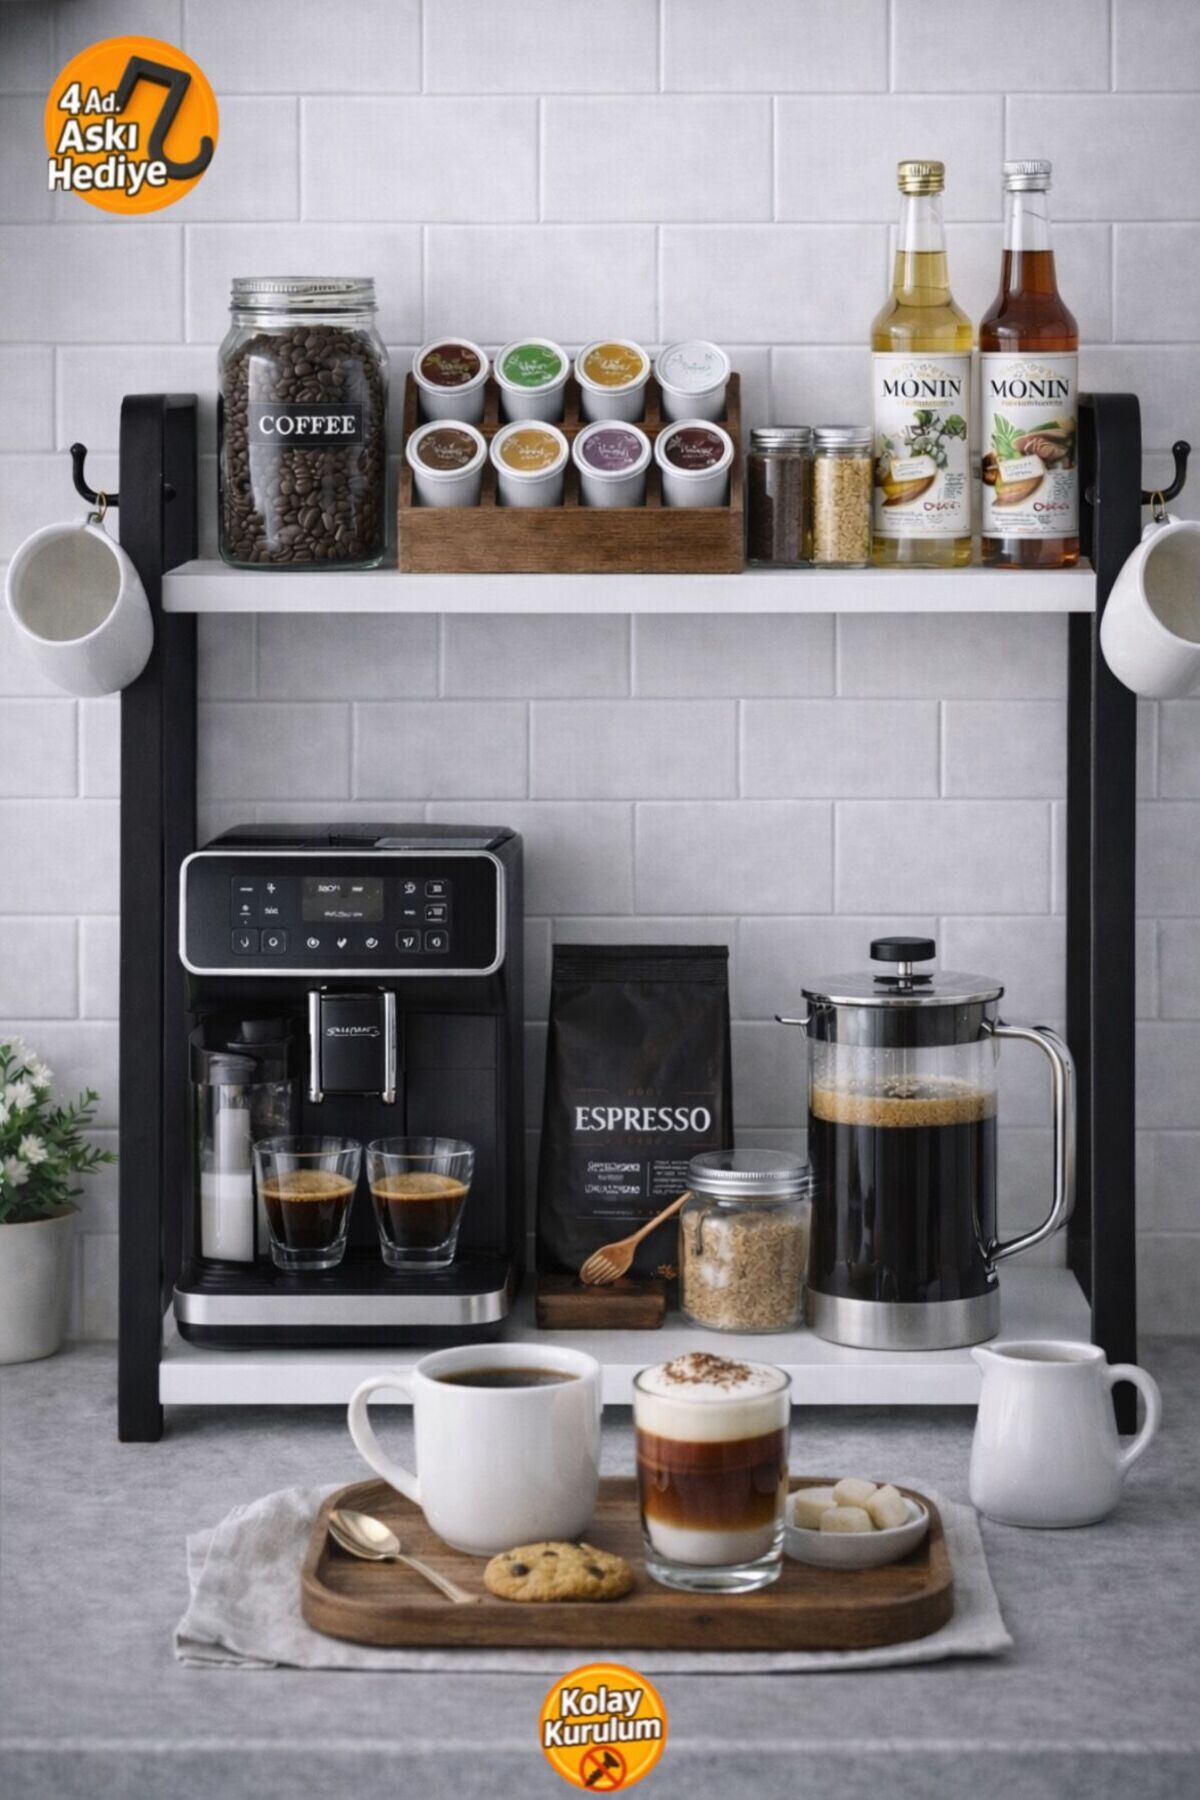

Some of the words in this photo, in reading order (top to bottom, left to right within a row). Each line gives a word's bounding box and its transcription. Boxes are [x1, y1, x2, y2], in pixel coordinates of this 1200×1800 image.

[882, 379, 962, 398] MONIN
[990, 379, 1070, 399] MONIN
[258, 415, 356, 435] COFFEE
[575, 1106, 712, 1132] ESPRESSO
